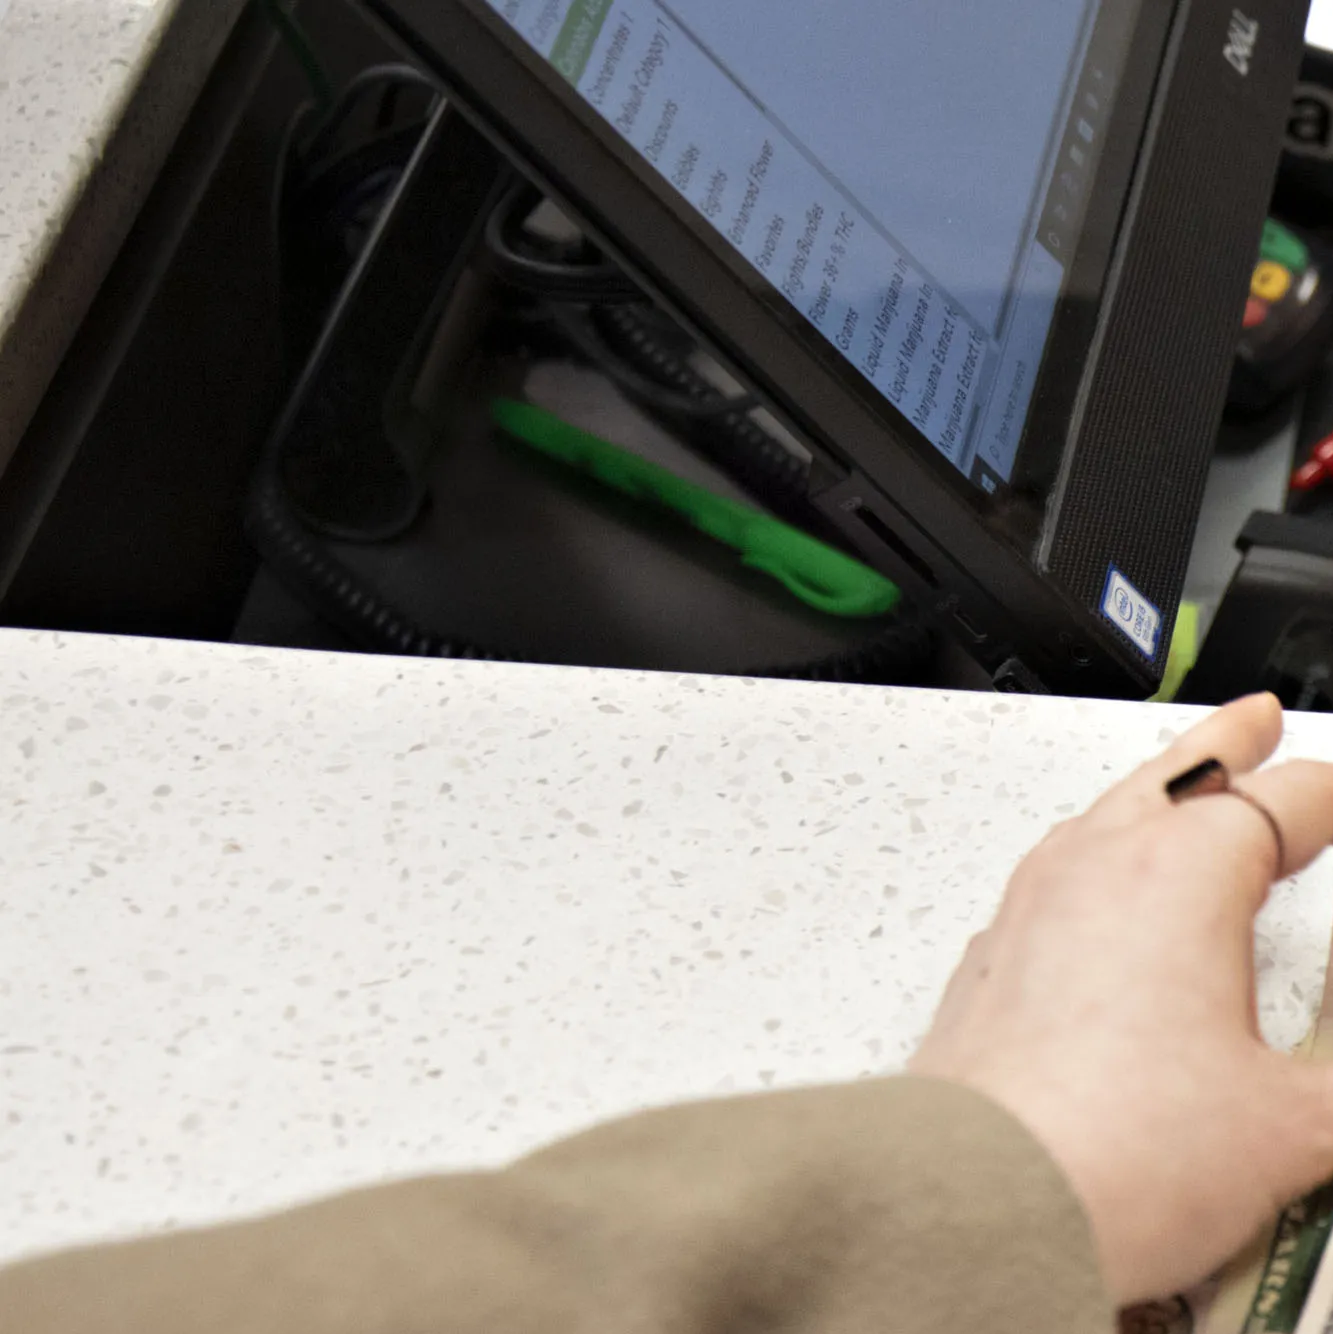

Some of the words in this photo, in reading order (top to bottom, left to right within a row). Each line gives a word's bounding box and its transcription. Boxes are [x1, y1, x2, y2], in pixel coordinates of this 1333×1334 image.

[1223, 7, 1258, 76] DELL
[615, 83, 645, 133] Default
[635, 32, 669, 86] Category
[644, 99, 678, 162] Discounts
[672, 143, 699, 190] Edibles
[700, 169, 727, 218] Eighths
[727, 177, 760, 245] Enhanced
[750, 139, 774, 181] Flower
[755, 214, 786, 272] Favorites
[809, 283, 832, 325] Flower
[835, 211, 855, 243] THC
[836, 307, 859, 351] Grams
[861, 329, 884, 378] Liquid
[874, 273, 905, 337] Marijuana
[899, 296, 930, 364] Marijuana
[888, 354, 911, 403] Liquid
[912, 367, 941, 430] Marijuana
[932, 319, 956, 370] Extract
[938, 387, 967, 453] Marijuana
[956, 345, 981, 393] Extract
